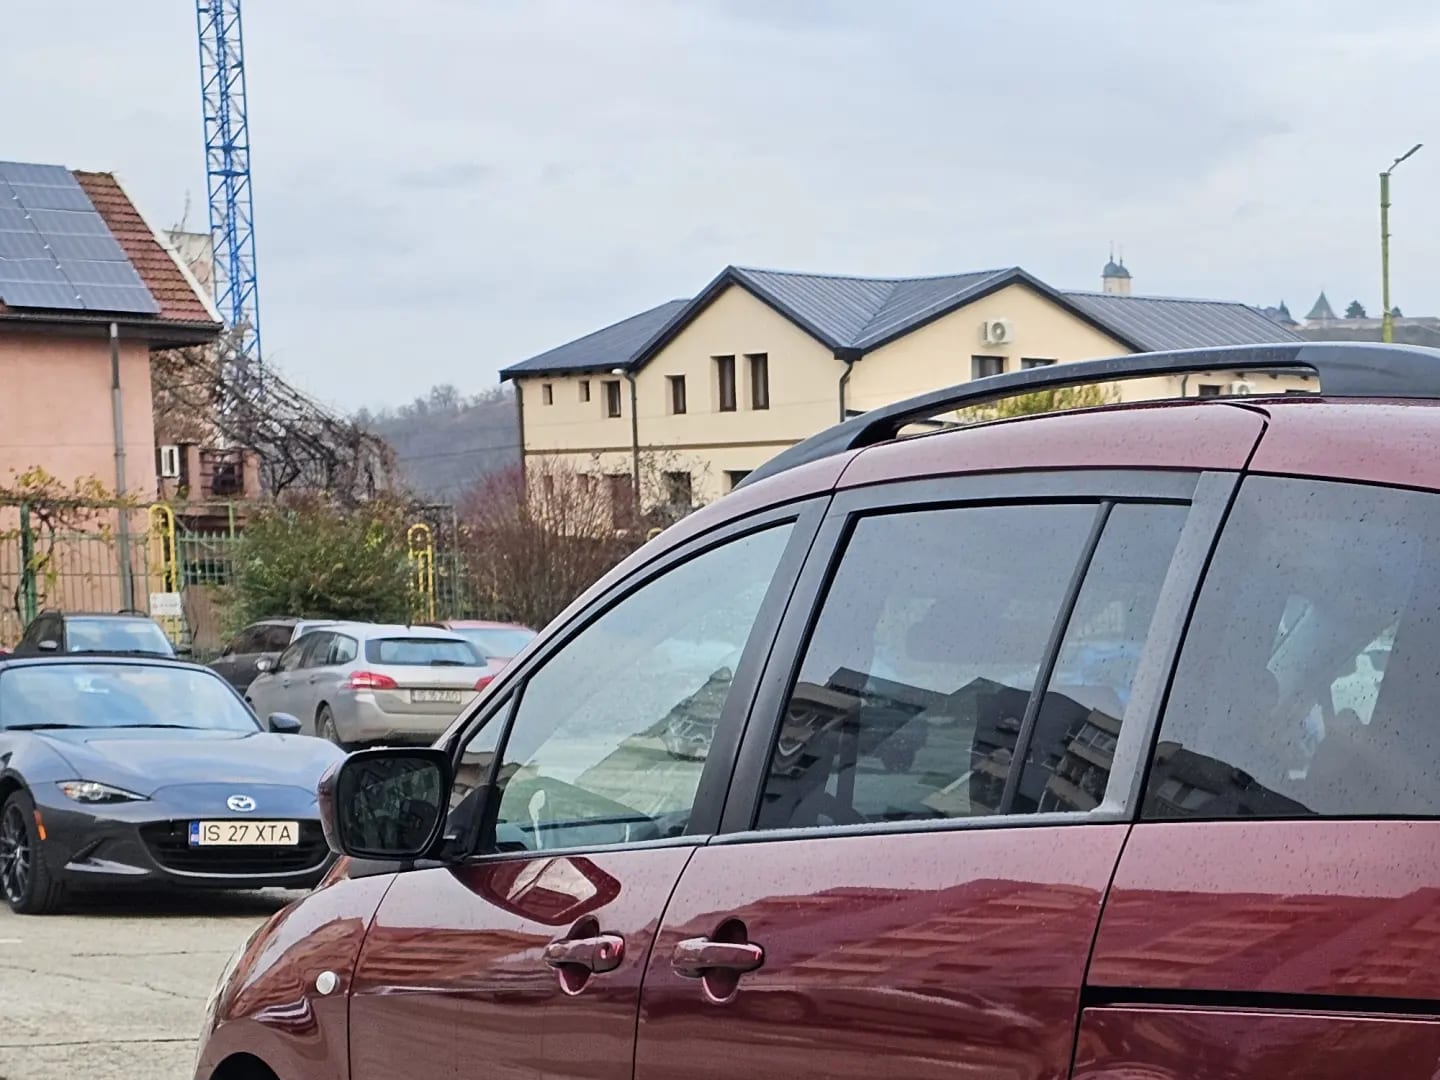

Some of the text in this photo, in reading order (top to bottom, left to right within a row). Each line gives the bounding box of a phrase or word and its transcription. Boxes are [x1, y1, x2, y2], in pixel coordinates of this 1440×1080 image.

[203, 825, 291, 841] IS 27 XTA
